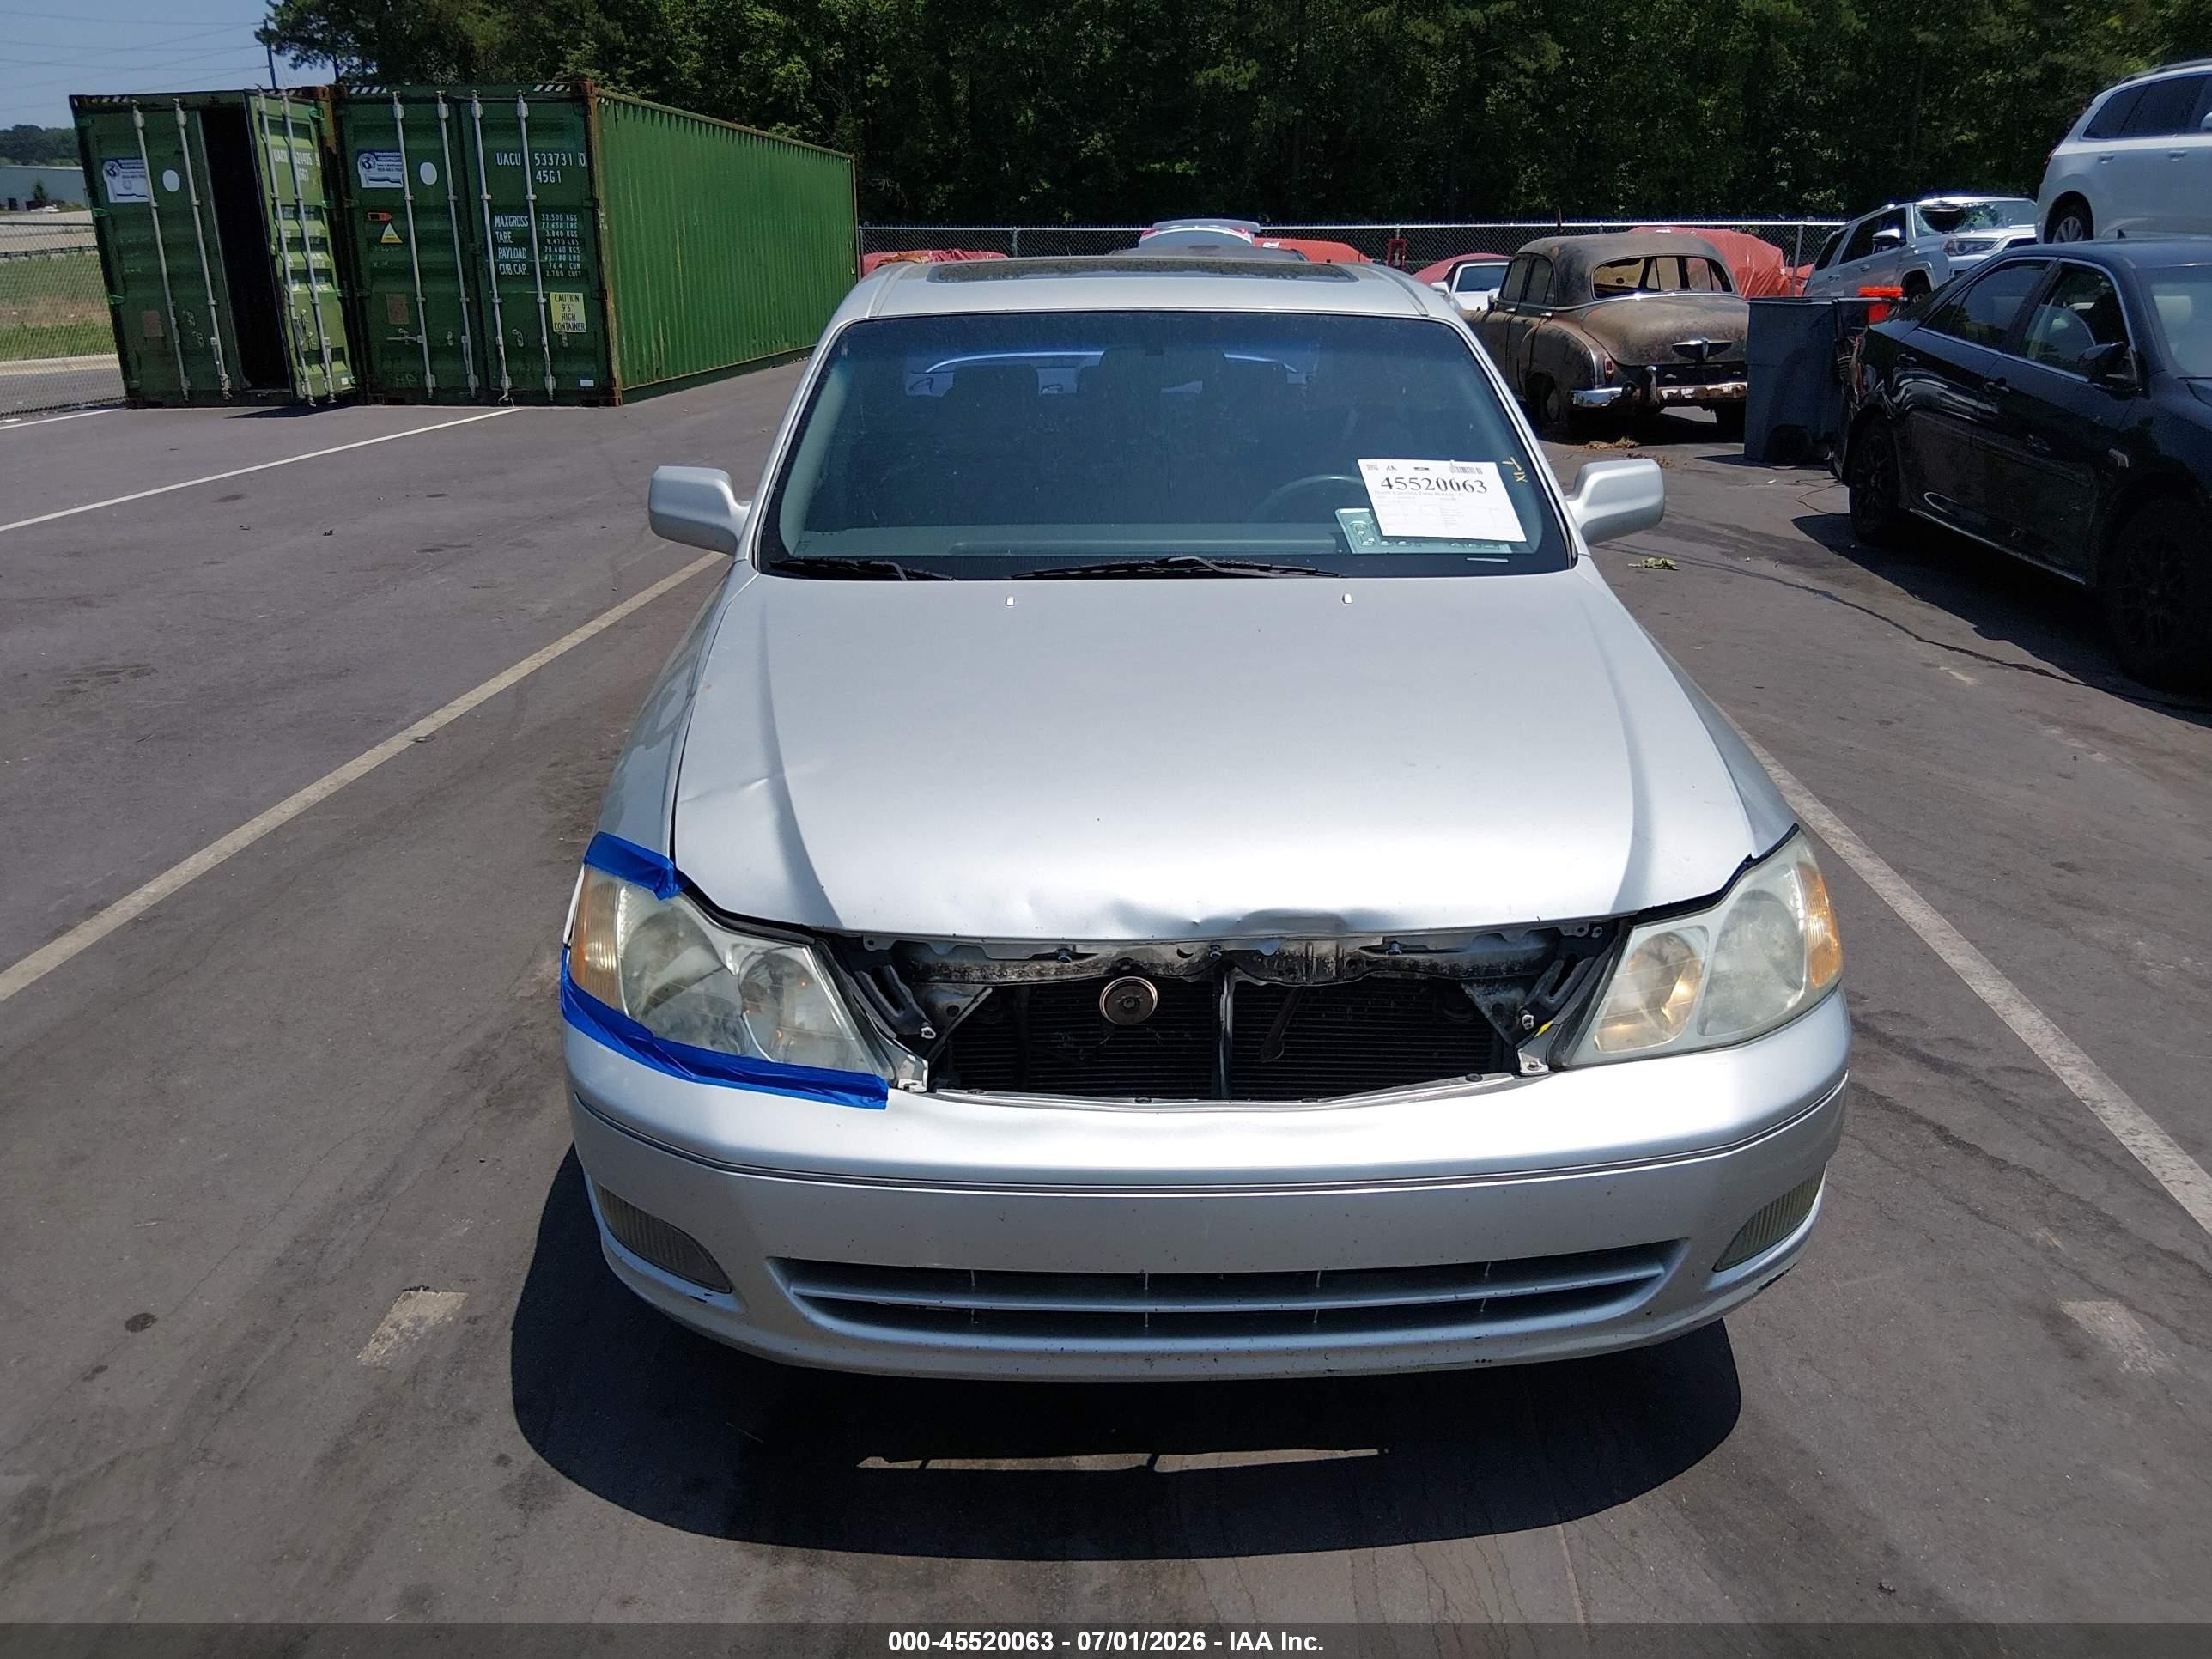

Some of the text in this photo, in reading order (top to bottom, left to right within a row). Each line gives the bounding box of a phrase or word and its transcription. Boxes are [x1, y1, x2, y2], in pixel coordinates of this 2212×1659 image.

[495, 152, 587, 167] UACU 533731 0
[536, 170, 562, 184] 45G1
[495, 231, 514, 244] TARE
[498, 246, 527, 260] PAYLOAD
[554, 294, 580, 303] CAUTION
[562, 313, 576, 322] HIGH
[554, 322, 586, 331] CONTAINER
[1380, 477, 1488, 494] 45520063
